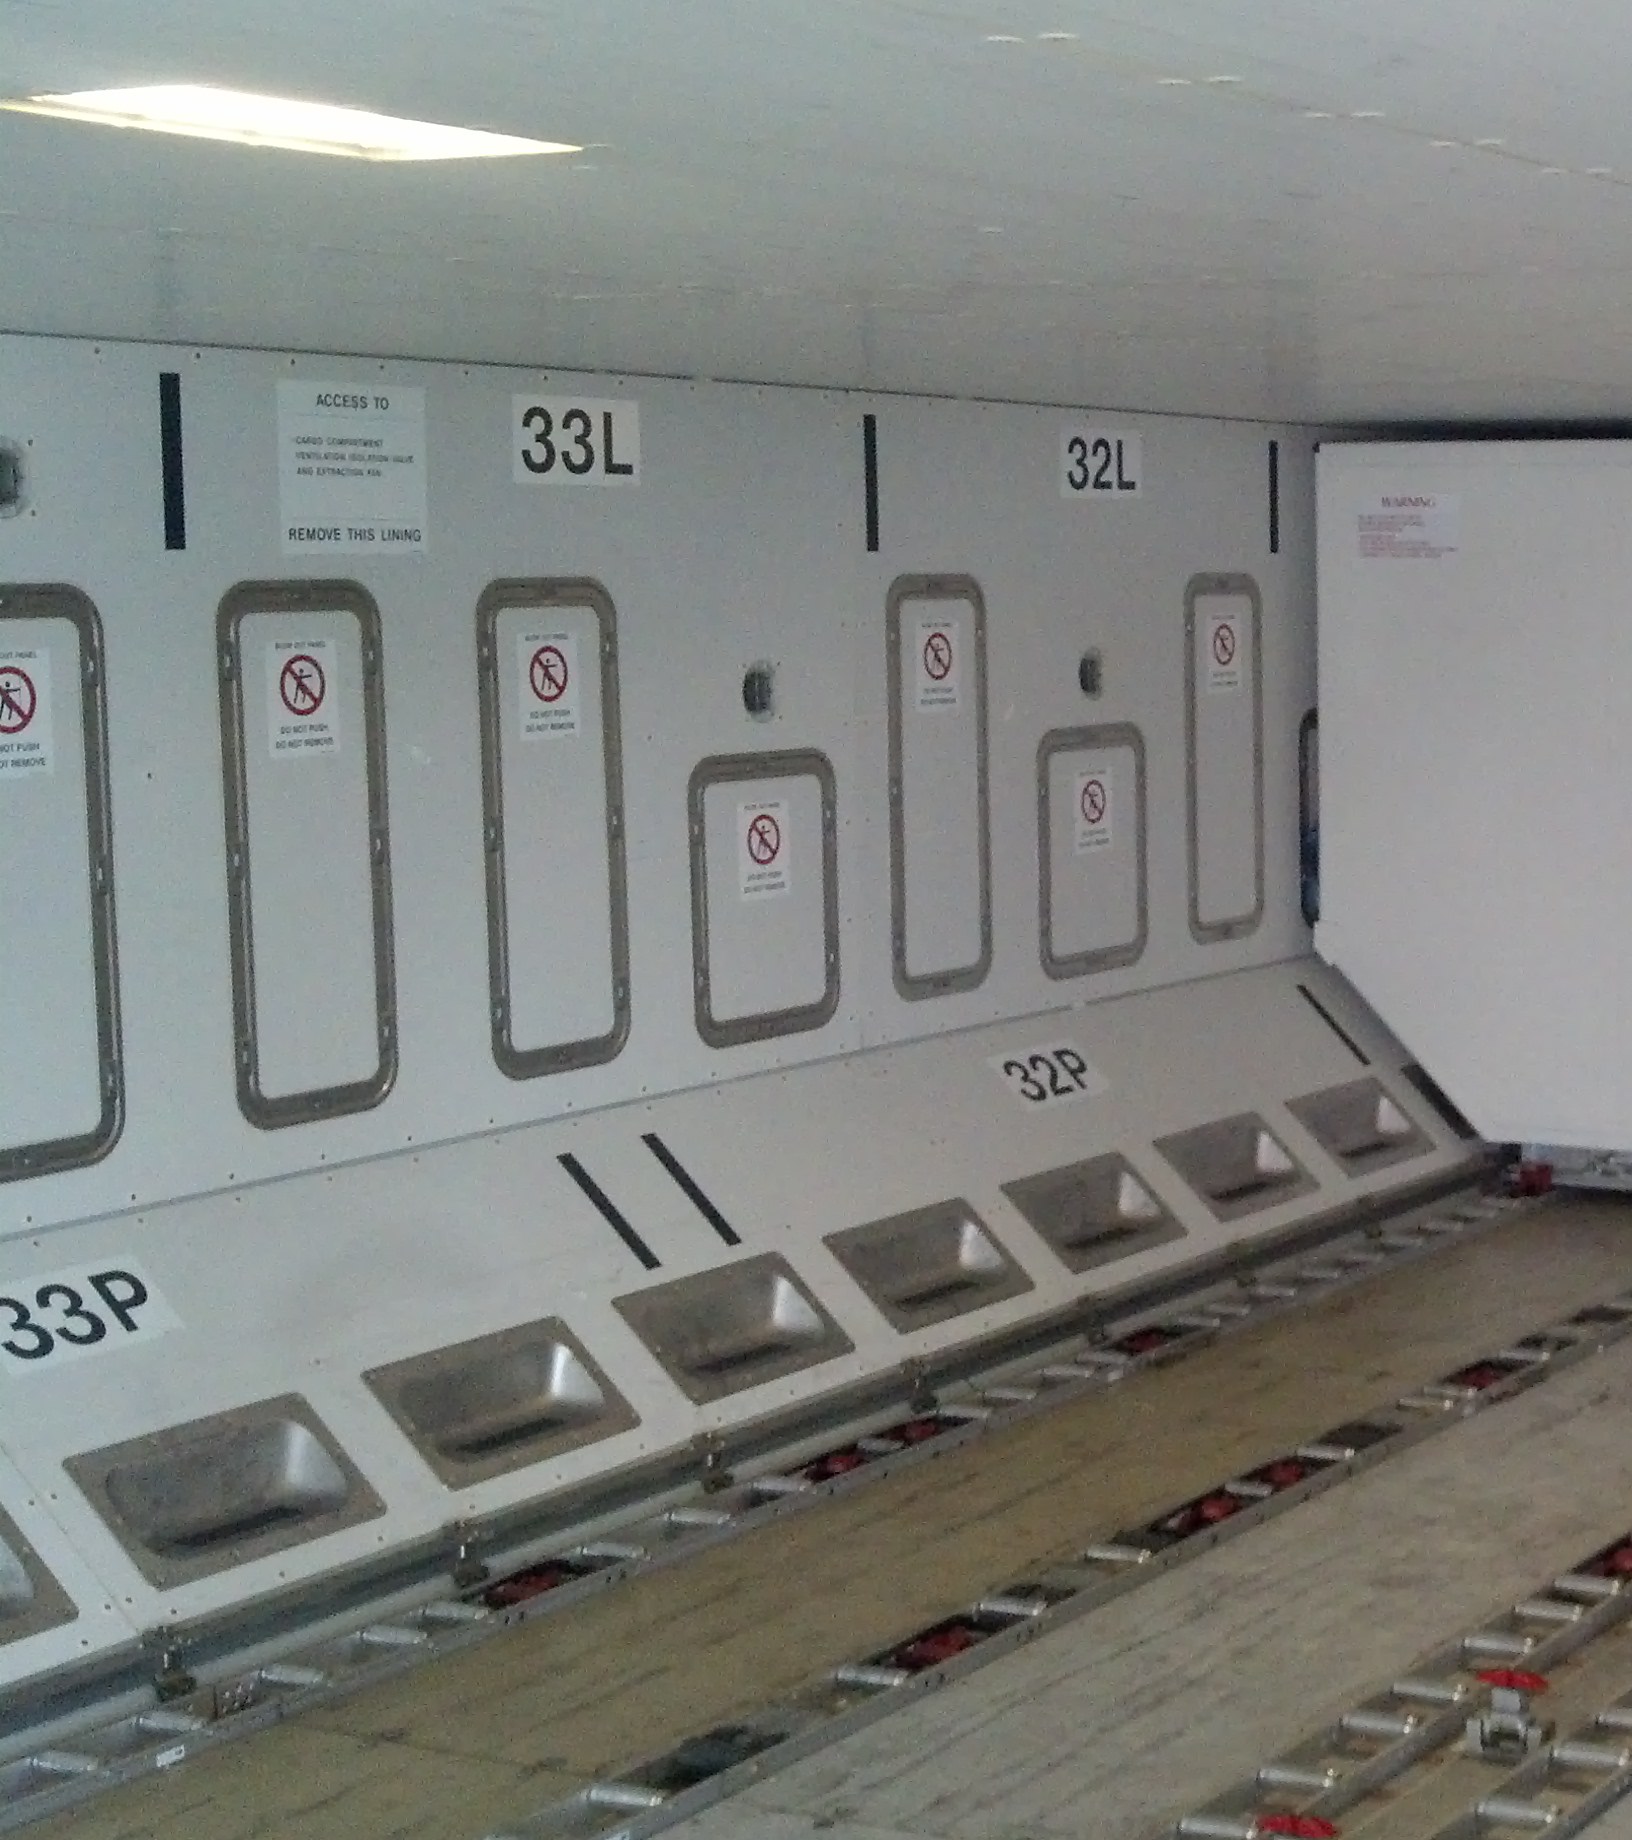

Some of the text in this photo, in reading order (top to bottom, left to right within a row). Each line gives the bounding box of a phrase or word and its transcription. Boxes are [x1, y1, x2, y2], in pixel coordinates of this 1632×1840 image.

[315, 393, 391, 411] ACCESS TO
[326, 437, 384, 448] COMPARTMENT
[521, 405, 634, 475] 33L
[1067, 436, 1136, 490] 32L
[288, 527, 422, 543] REMOVE THIS LINING
[1003, 1048, 1087, 1101] 32P
[0, 1269, 148, 1360] 33P
